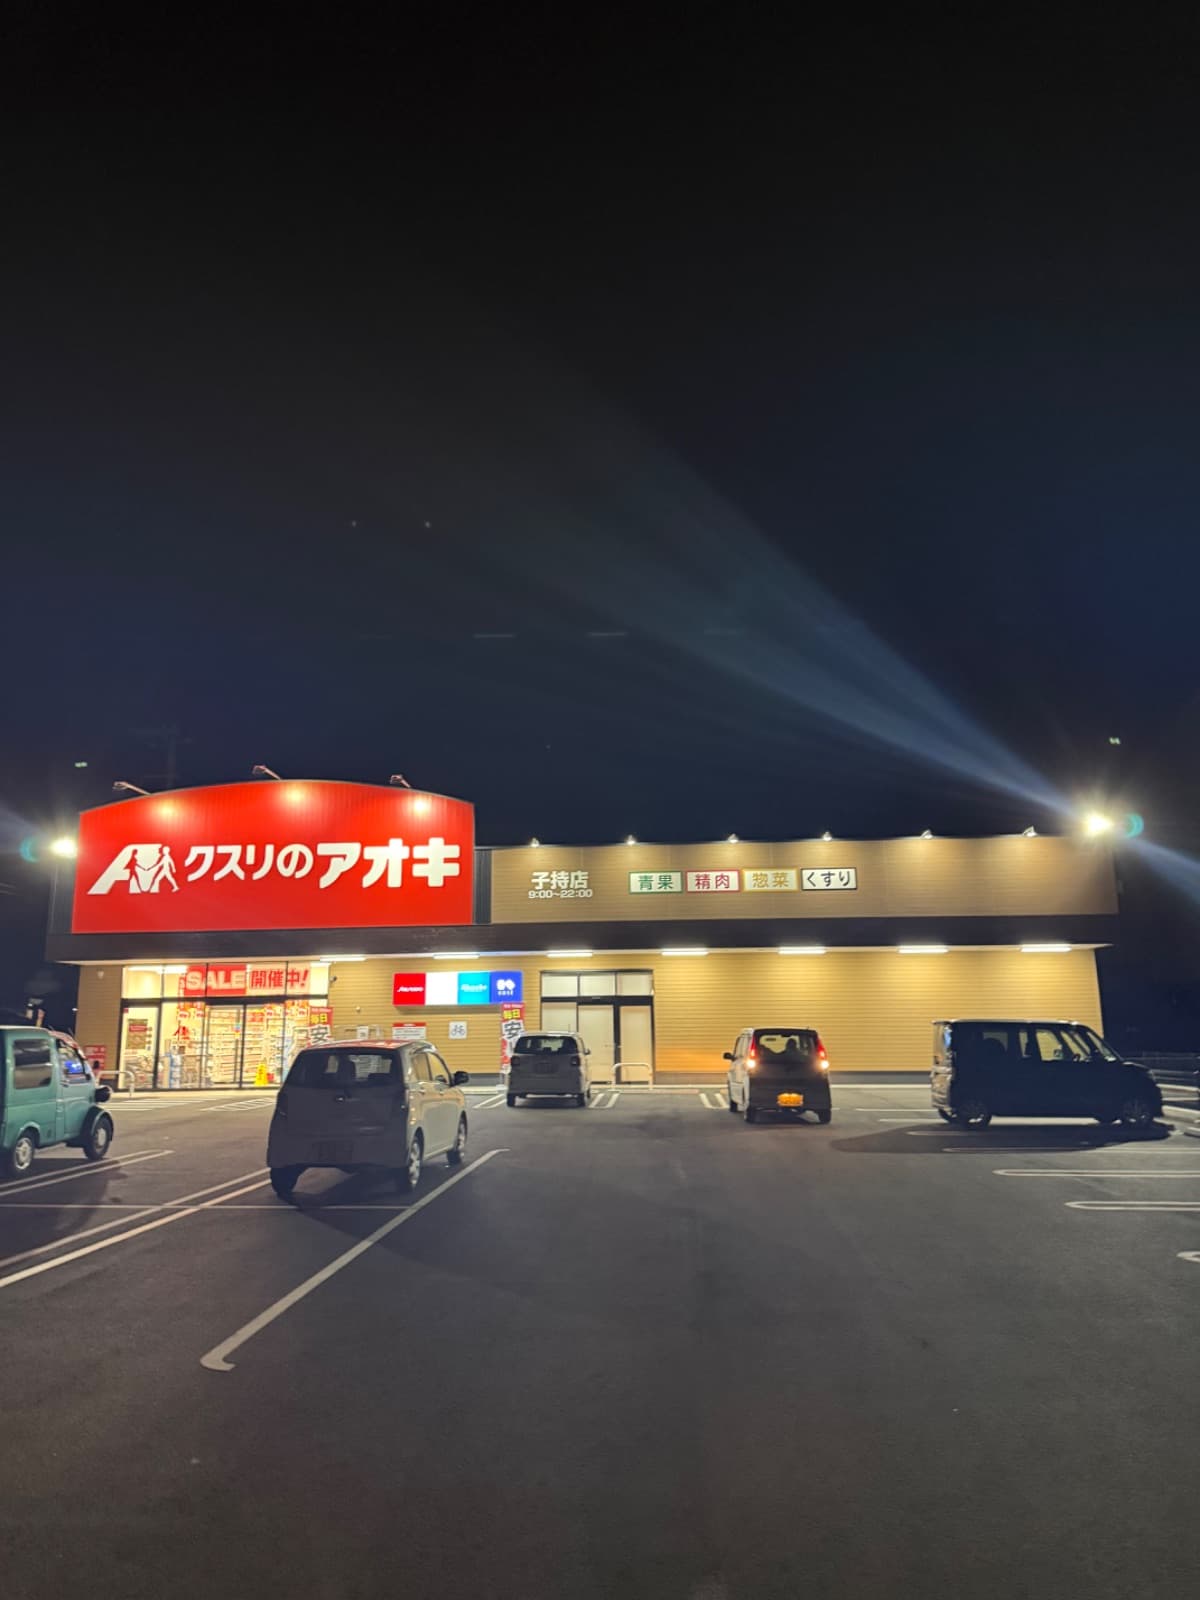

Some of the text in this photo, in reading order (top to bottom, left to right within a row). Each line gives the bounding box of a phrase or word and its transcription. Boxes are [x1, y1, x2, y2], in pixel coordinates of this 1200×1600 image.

[184, 837, 460, 889] クスリのアオキ
[531, 870, 589, 890] 子持店
[637, 875, 674, 891] 青果
[694, 873, 730, 890] 精肉
[752, 872, 789, 888] 惣菜
[806, 871, 851, 887] くすり
[186, 968, 309, 991] SALE 開催中!
